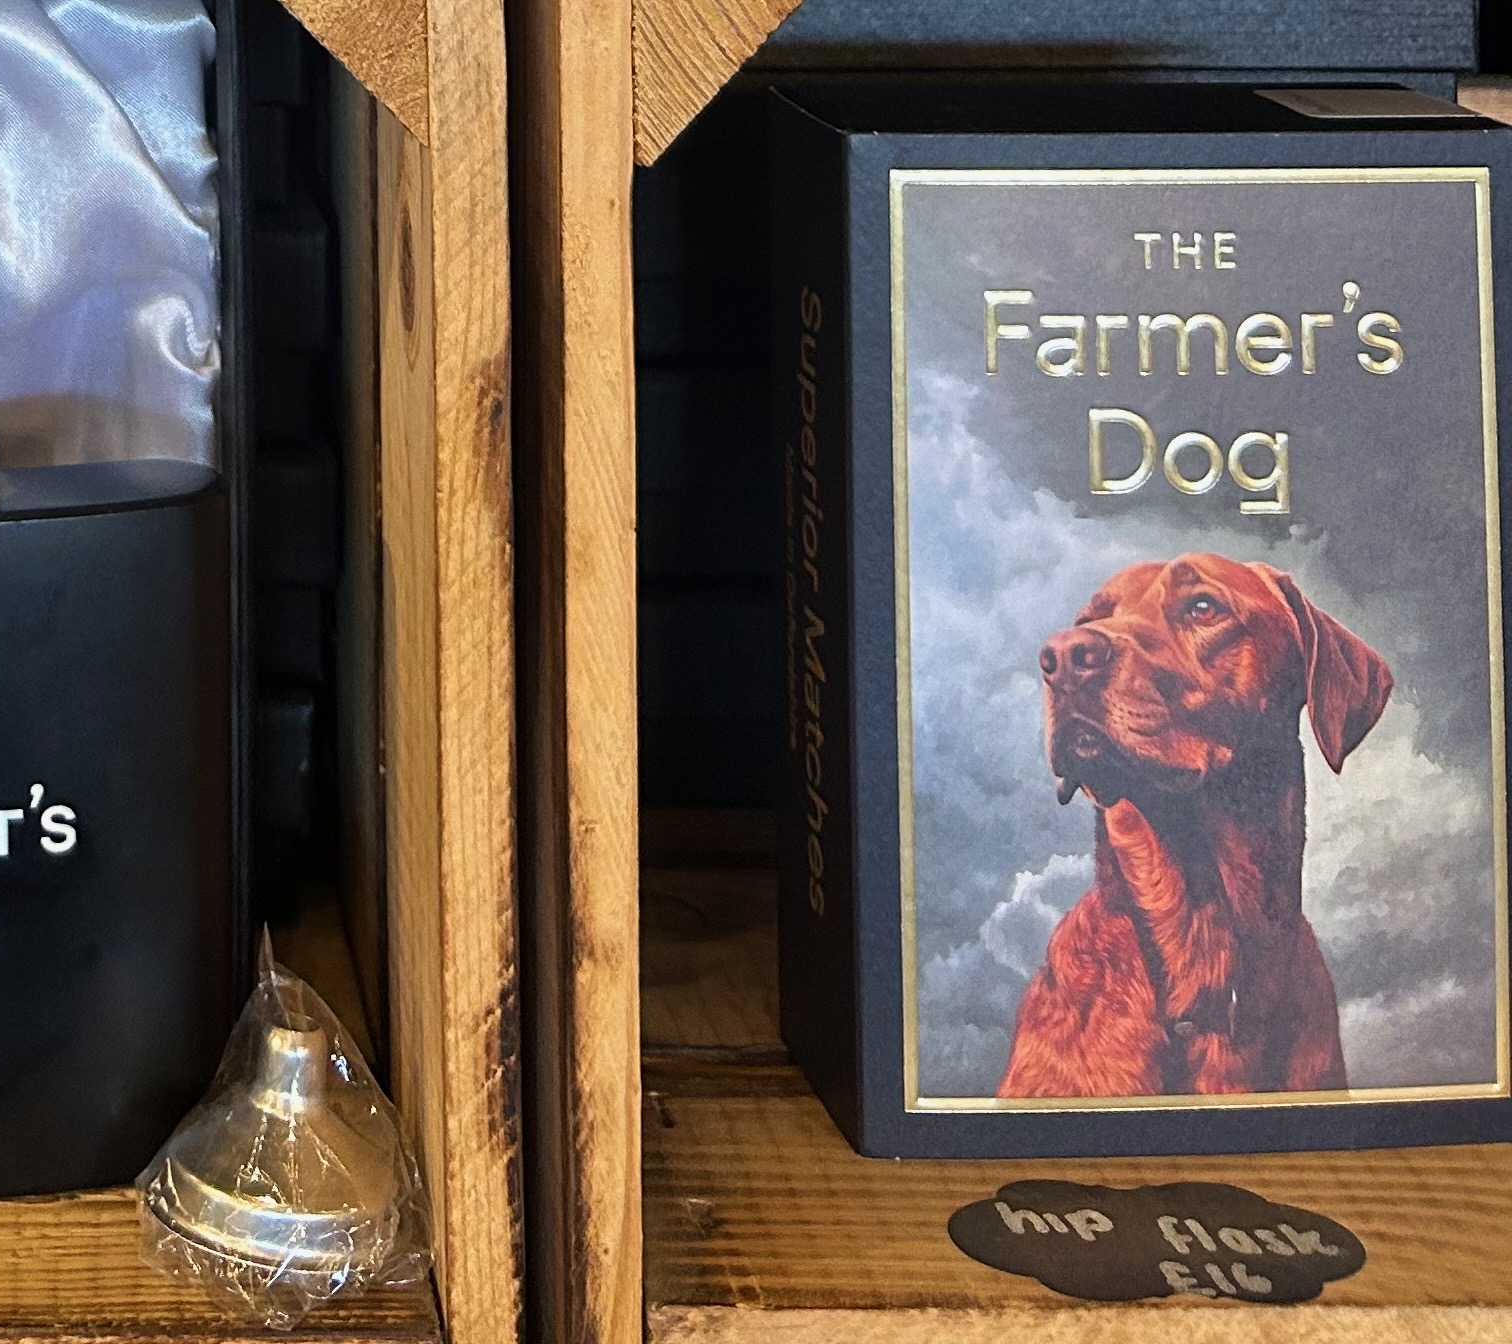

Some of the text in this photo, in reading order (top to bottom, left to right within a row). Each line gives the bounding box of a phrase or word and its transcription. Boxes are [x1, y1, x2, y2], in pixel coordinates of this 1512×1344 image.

[1134, 231, 1238, 270] THE
[983, 281, 1405, 378] Farmer's
[1089, 408, 1289, 515] Dog
[796, 286, 830, 918] Superior Matches
[995, 1201, 1342, 1257] hip flask
